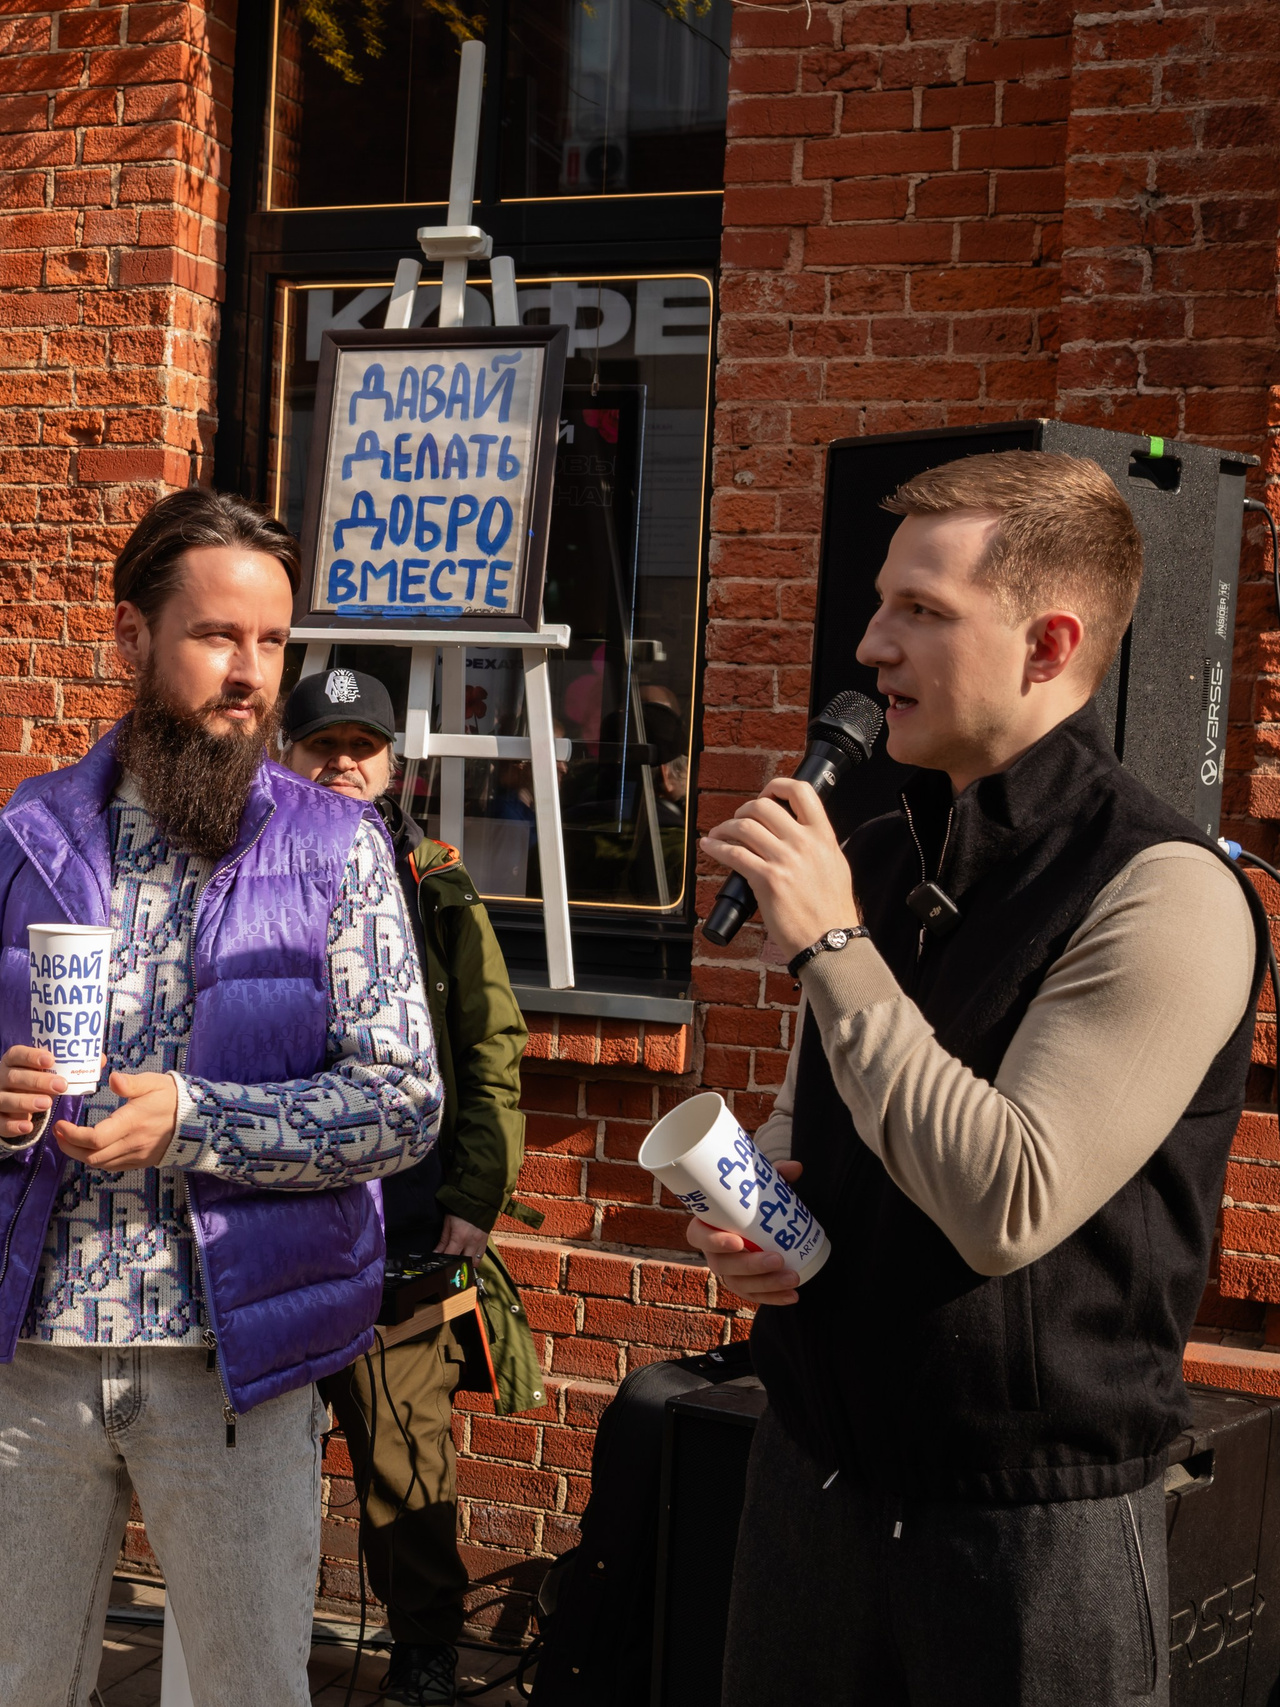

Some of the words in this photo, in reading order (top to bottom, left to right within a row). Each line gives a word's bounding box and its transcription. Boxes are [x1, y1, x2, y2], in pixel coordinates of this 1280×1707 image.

[348, 351, 522, 426] ДАВАЙ
[341, 430, 521, 482] ДЕЛАТЬ
[332, 490, 514, 556] ДОБРО
[326, 558, 513, 608] ВМЕСТЕ
[1205, 667, 1223, 756] VERSE
